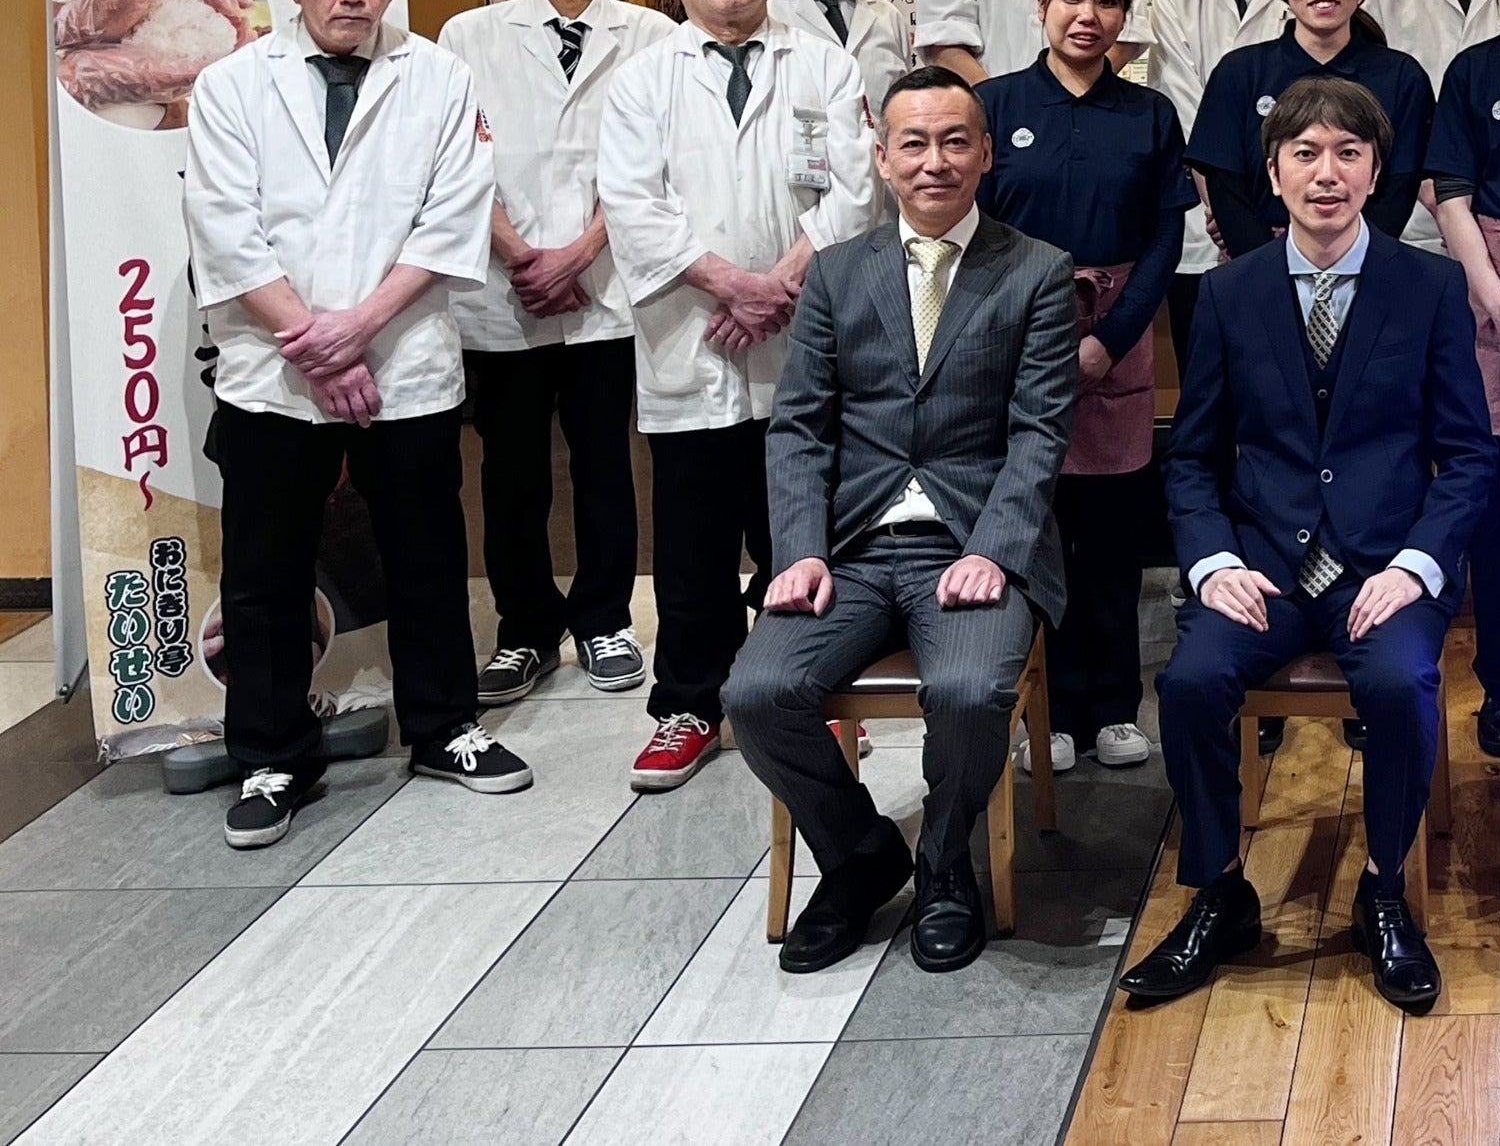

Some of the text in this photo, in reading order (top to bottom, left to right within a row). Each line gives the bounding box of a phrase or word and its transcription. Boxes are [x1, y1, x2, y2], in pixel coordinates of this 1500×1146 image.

[106, 571, 155, 725] たいせい
[151, 537, 193, 677] おにぎり亭
